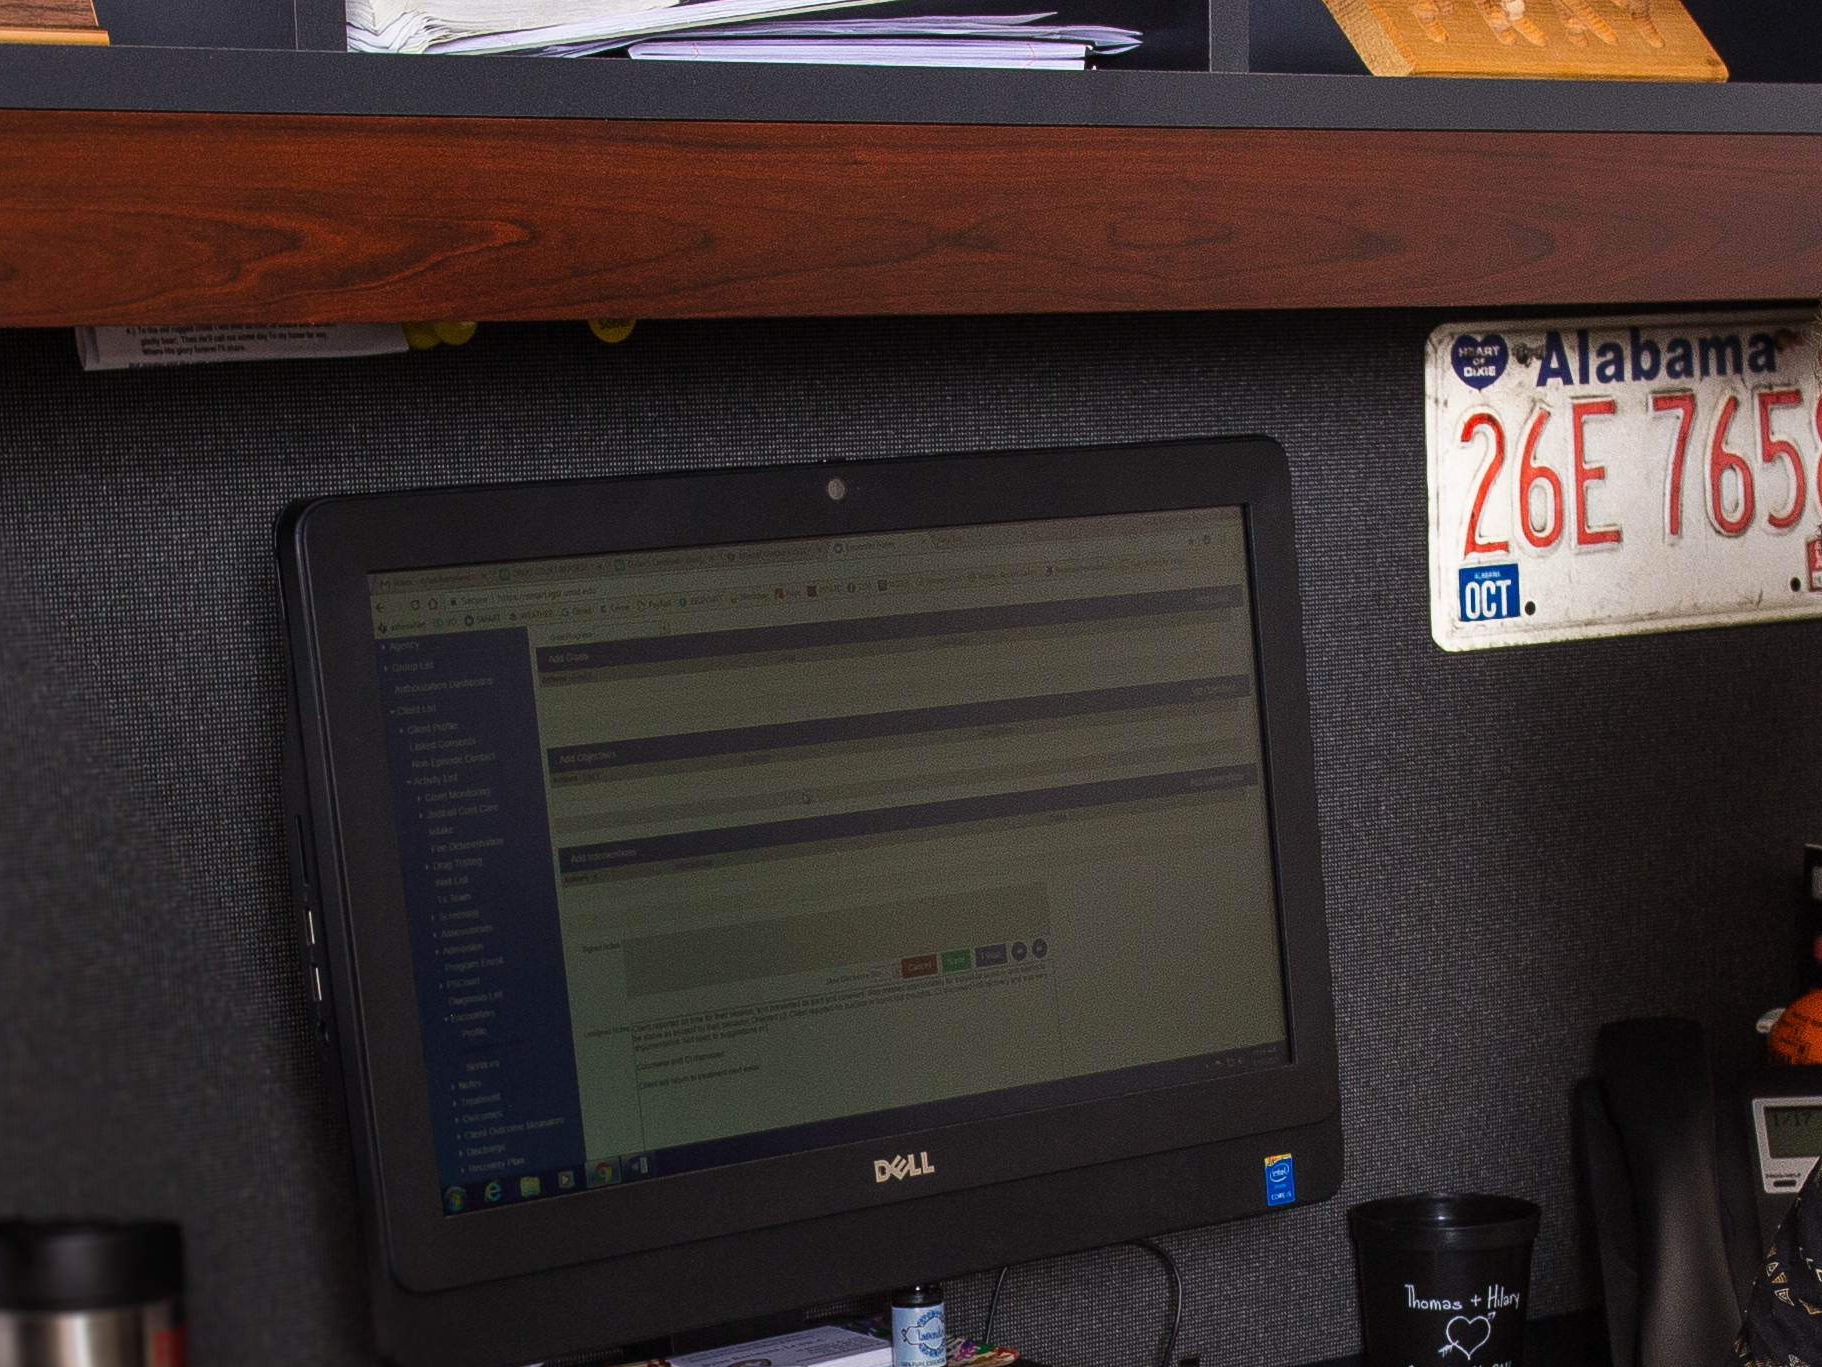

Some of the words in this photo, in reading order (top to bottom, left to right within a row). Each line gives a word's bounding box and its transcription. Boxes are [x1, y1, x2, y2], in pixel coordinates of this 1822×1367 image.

[1536, 328, 1776, 387] Alabama
[1460, 397, 1622, 559] 26E
[1465, 579, 1512, 620] OCT
[874, 1151, 935, 1183] DELL
[1404, 1283, 1463, 1312] Thomas
[1486, 1283, 1521, 1313] Hilary
